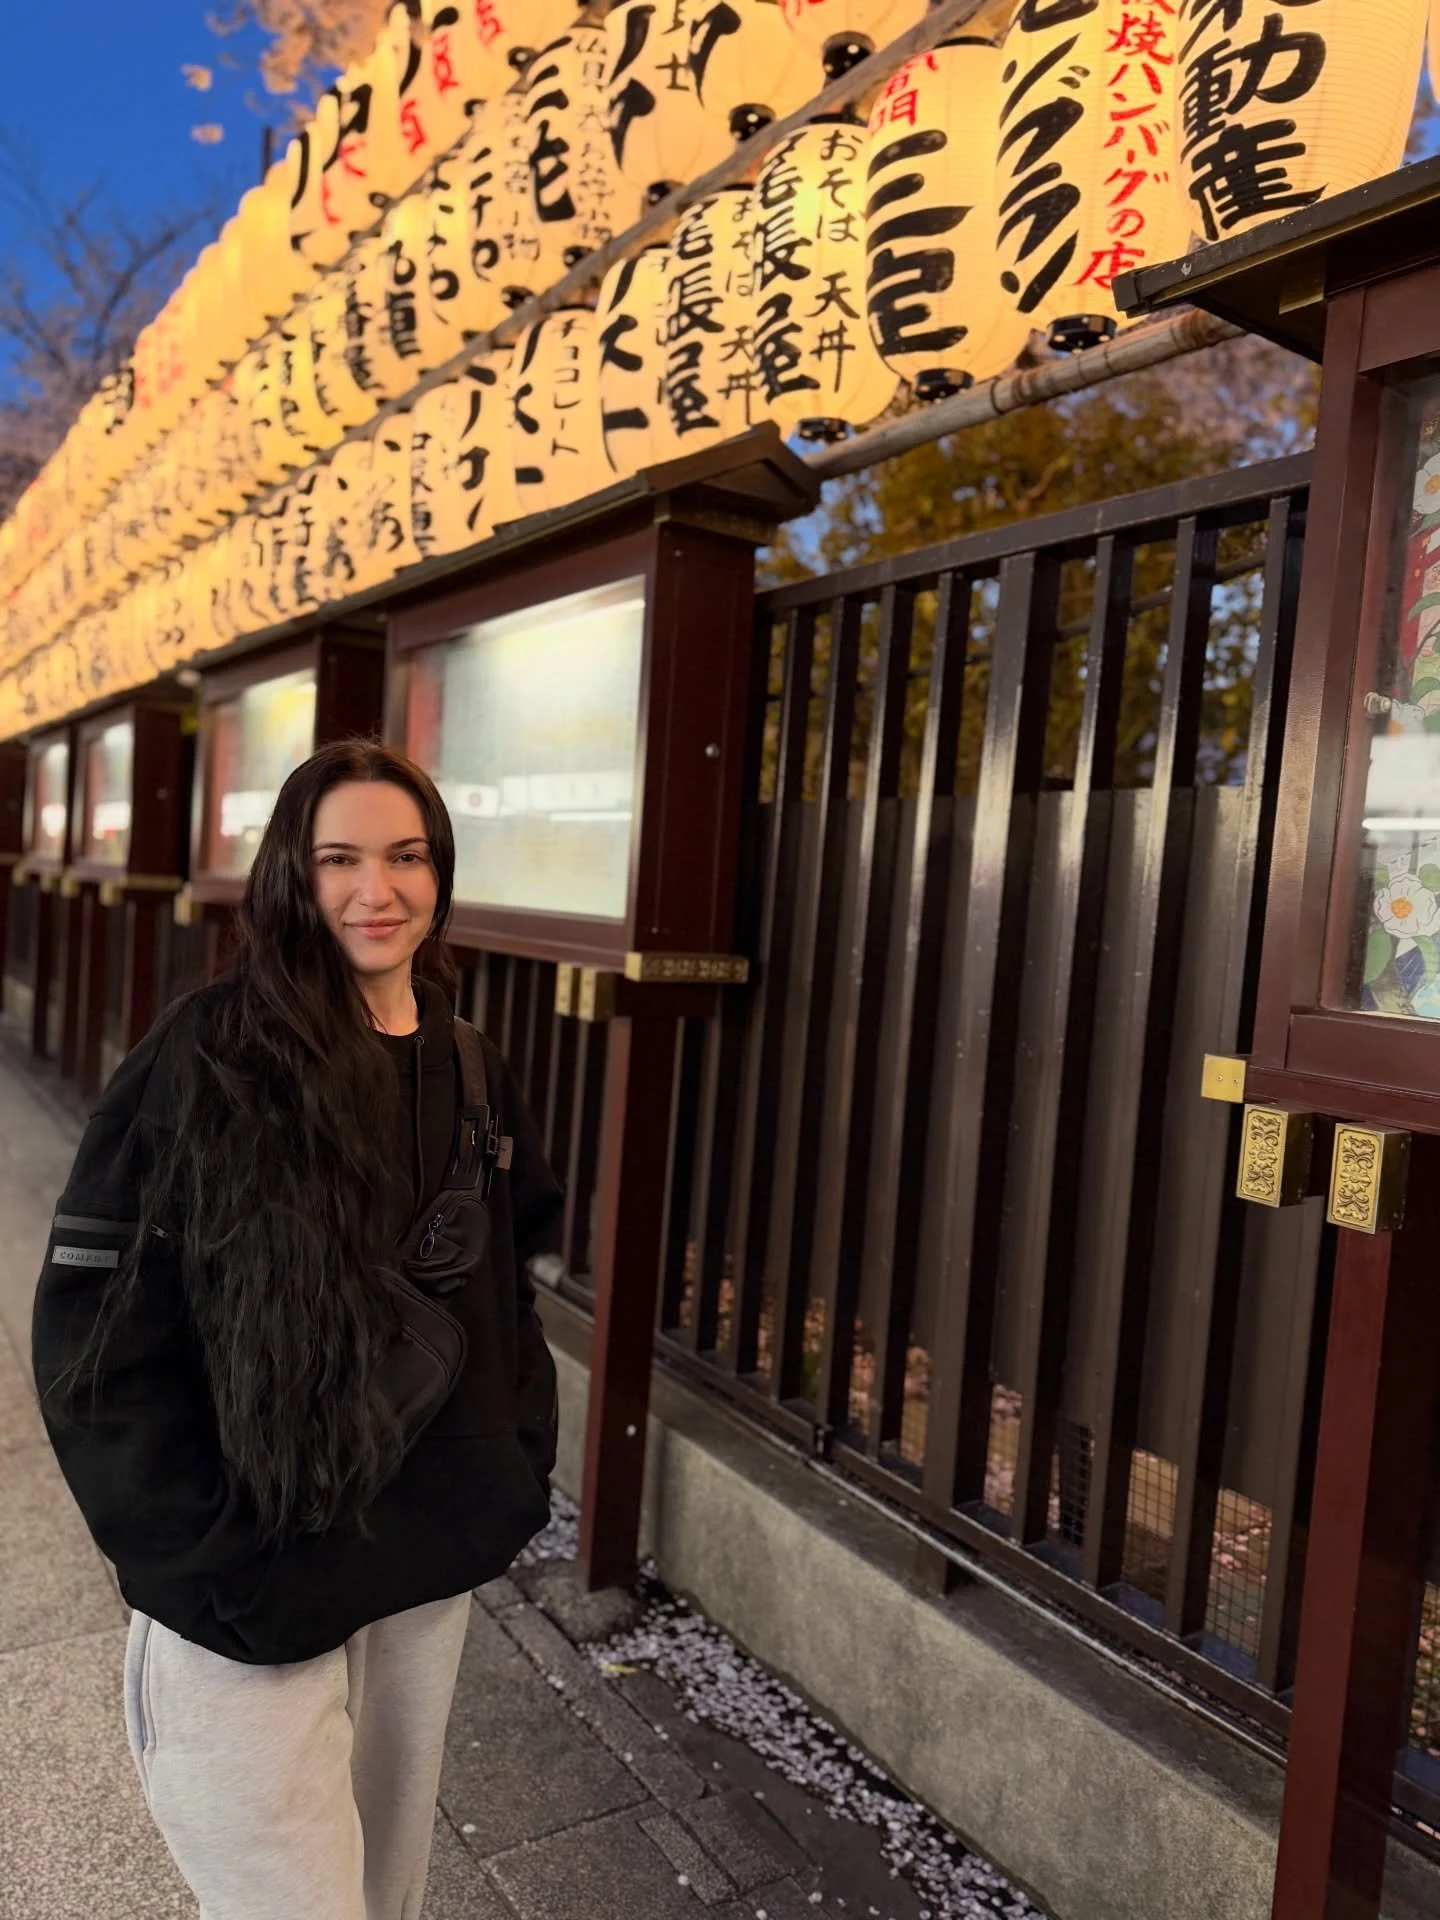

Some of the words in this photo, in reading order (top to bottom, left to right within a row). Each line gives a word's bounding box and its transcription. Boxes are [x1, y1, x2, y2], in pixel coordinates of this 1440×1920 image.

[996, 0, 1099, 313] ンブラン
[1073, 0, 1176, 290] 焼ハンバーグの店
